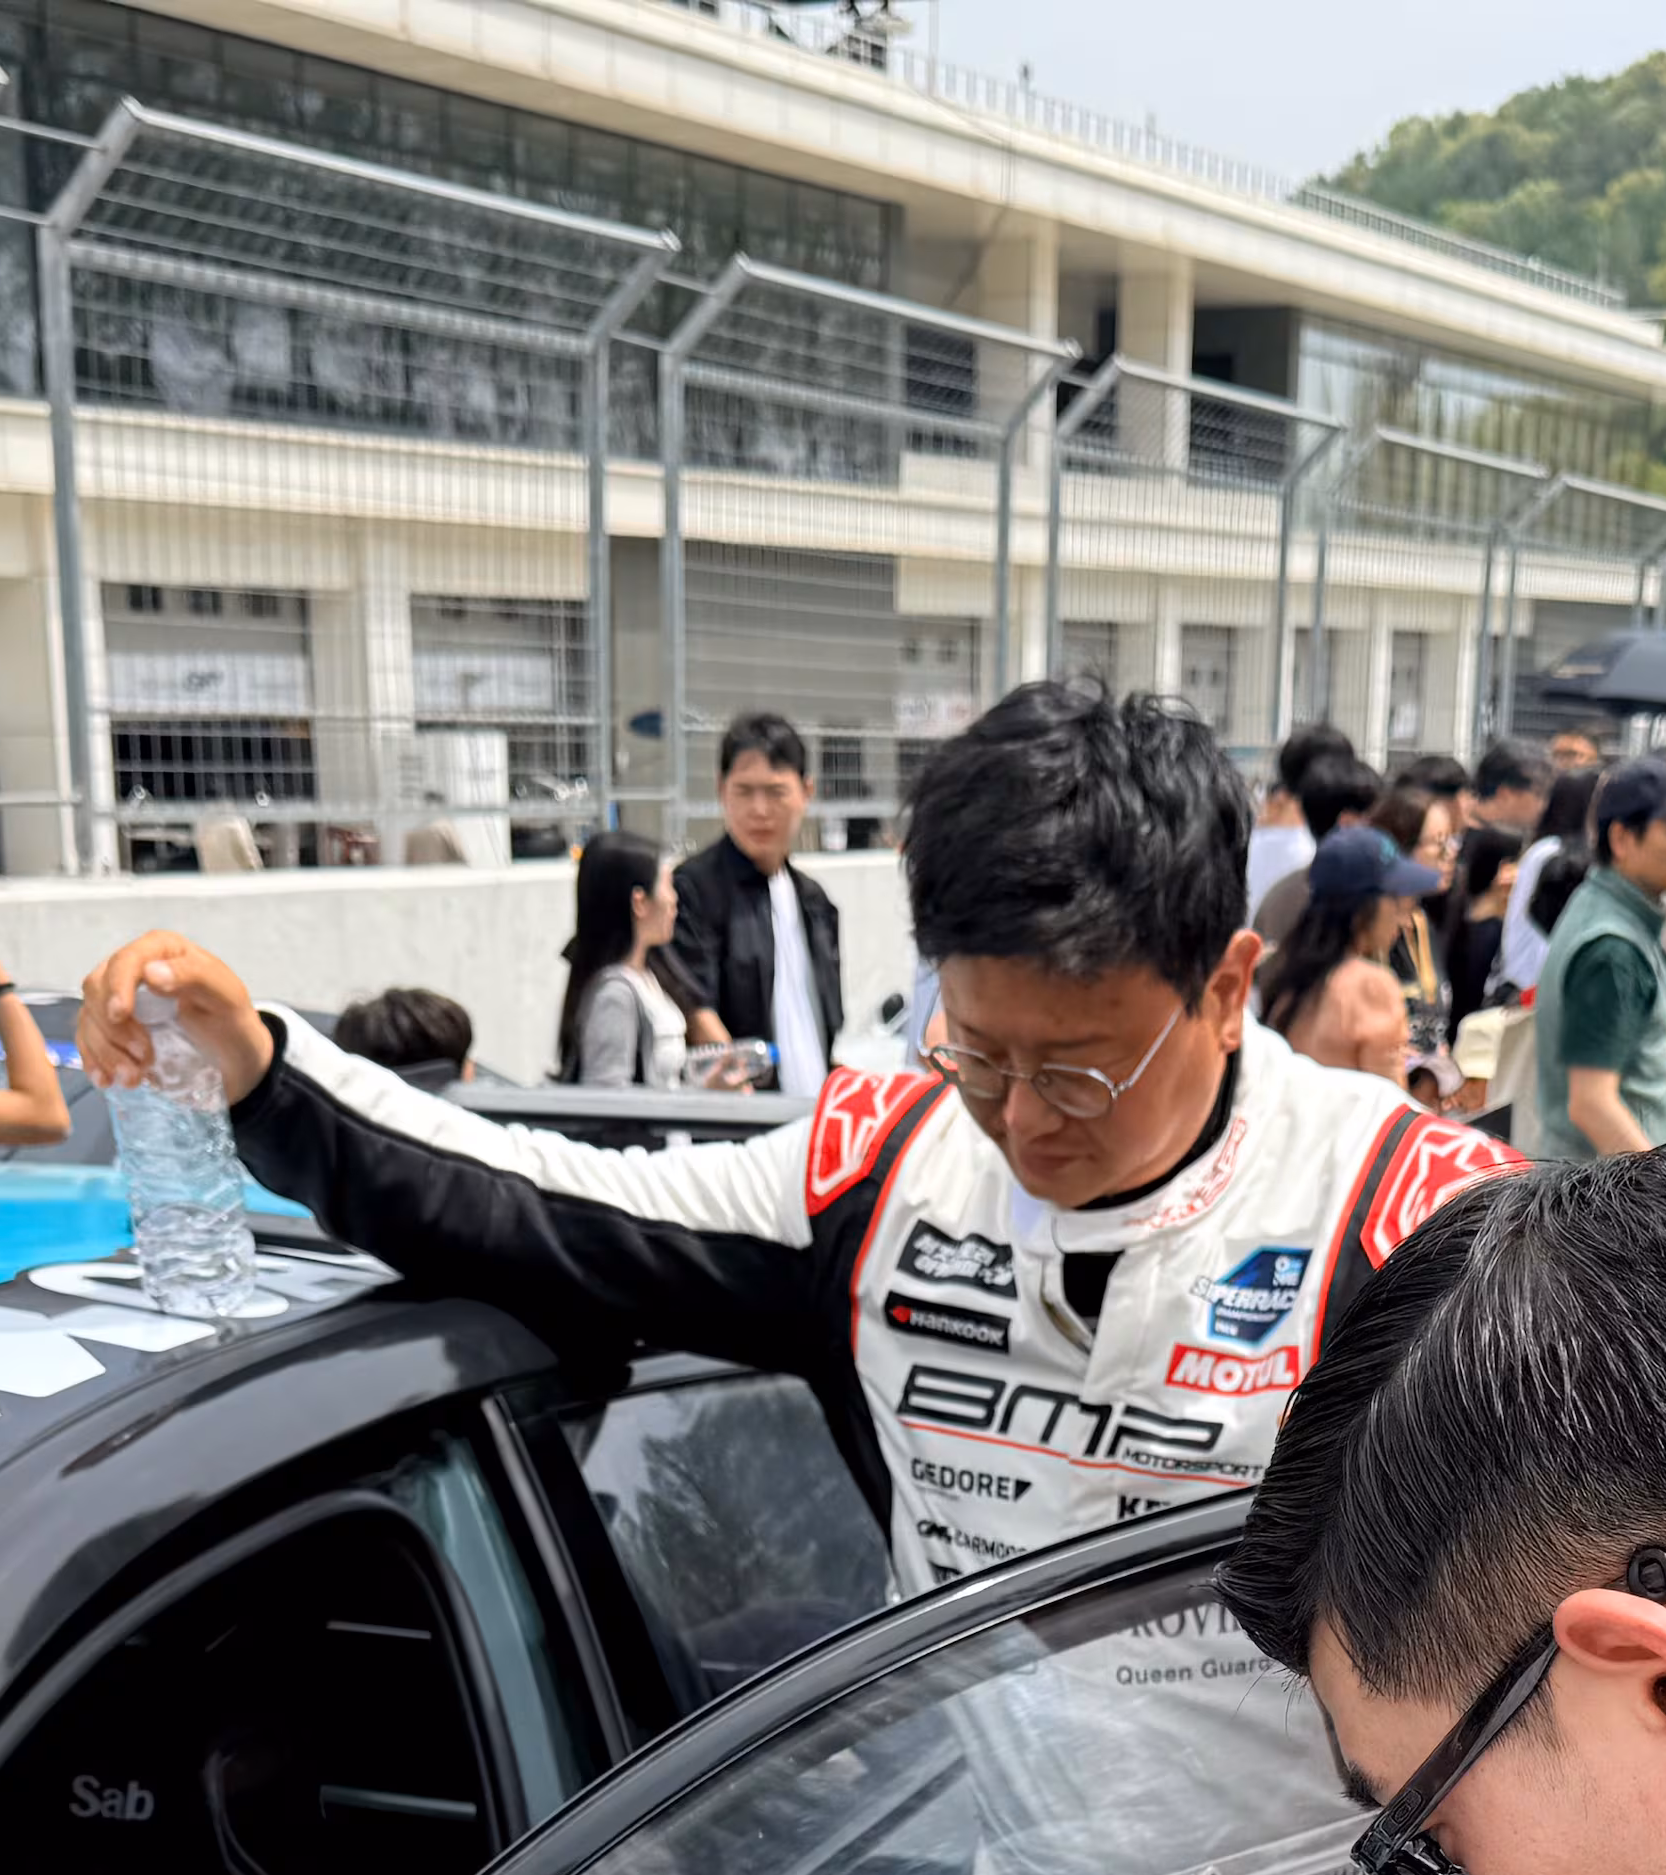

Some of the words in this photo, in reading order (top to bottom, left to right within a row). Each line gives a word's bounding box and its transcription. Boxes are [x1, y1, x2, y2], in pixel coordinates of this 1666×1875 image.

[1189, 1275, 1301, 1314] SUPERRAC
[1171, 1350, 1295, 1394] MOTUL
[911, 1458, 1010, 1502] GEDORE
[1122, 1448, 1263, 1479] MOTORSPORT
[1116, 1664, 1193, 1686] Queen
